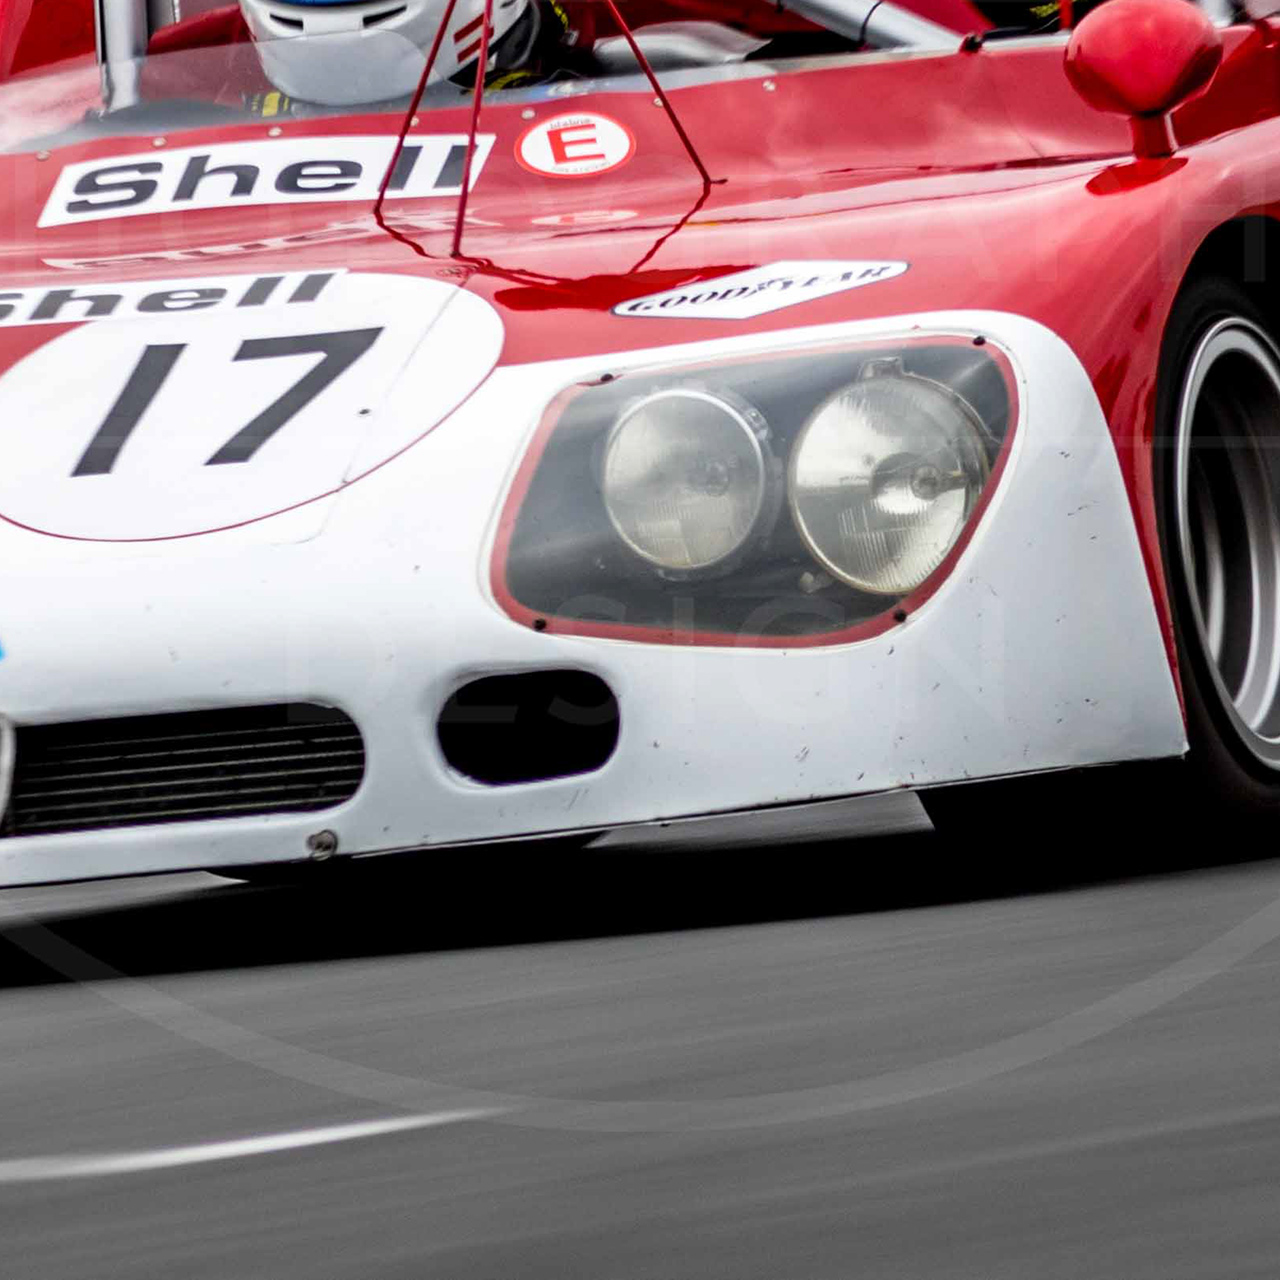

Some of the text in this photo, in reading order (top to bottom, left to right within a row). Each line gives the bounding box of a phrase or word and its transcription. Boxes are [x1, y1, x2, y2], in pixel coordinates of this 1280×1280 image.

[66, 142, 478, 214] Shell
[547, 123, 606, 165] E
[70, 326, 386, 478] 17
